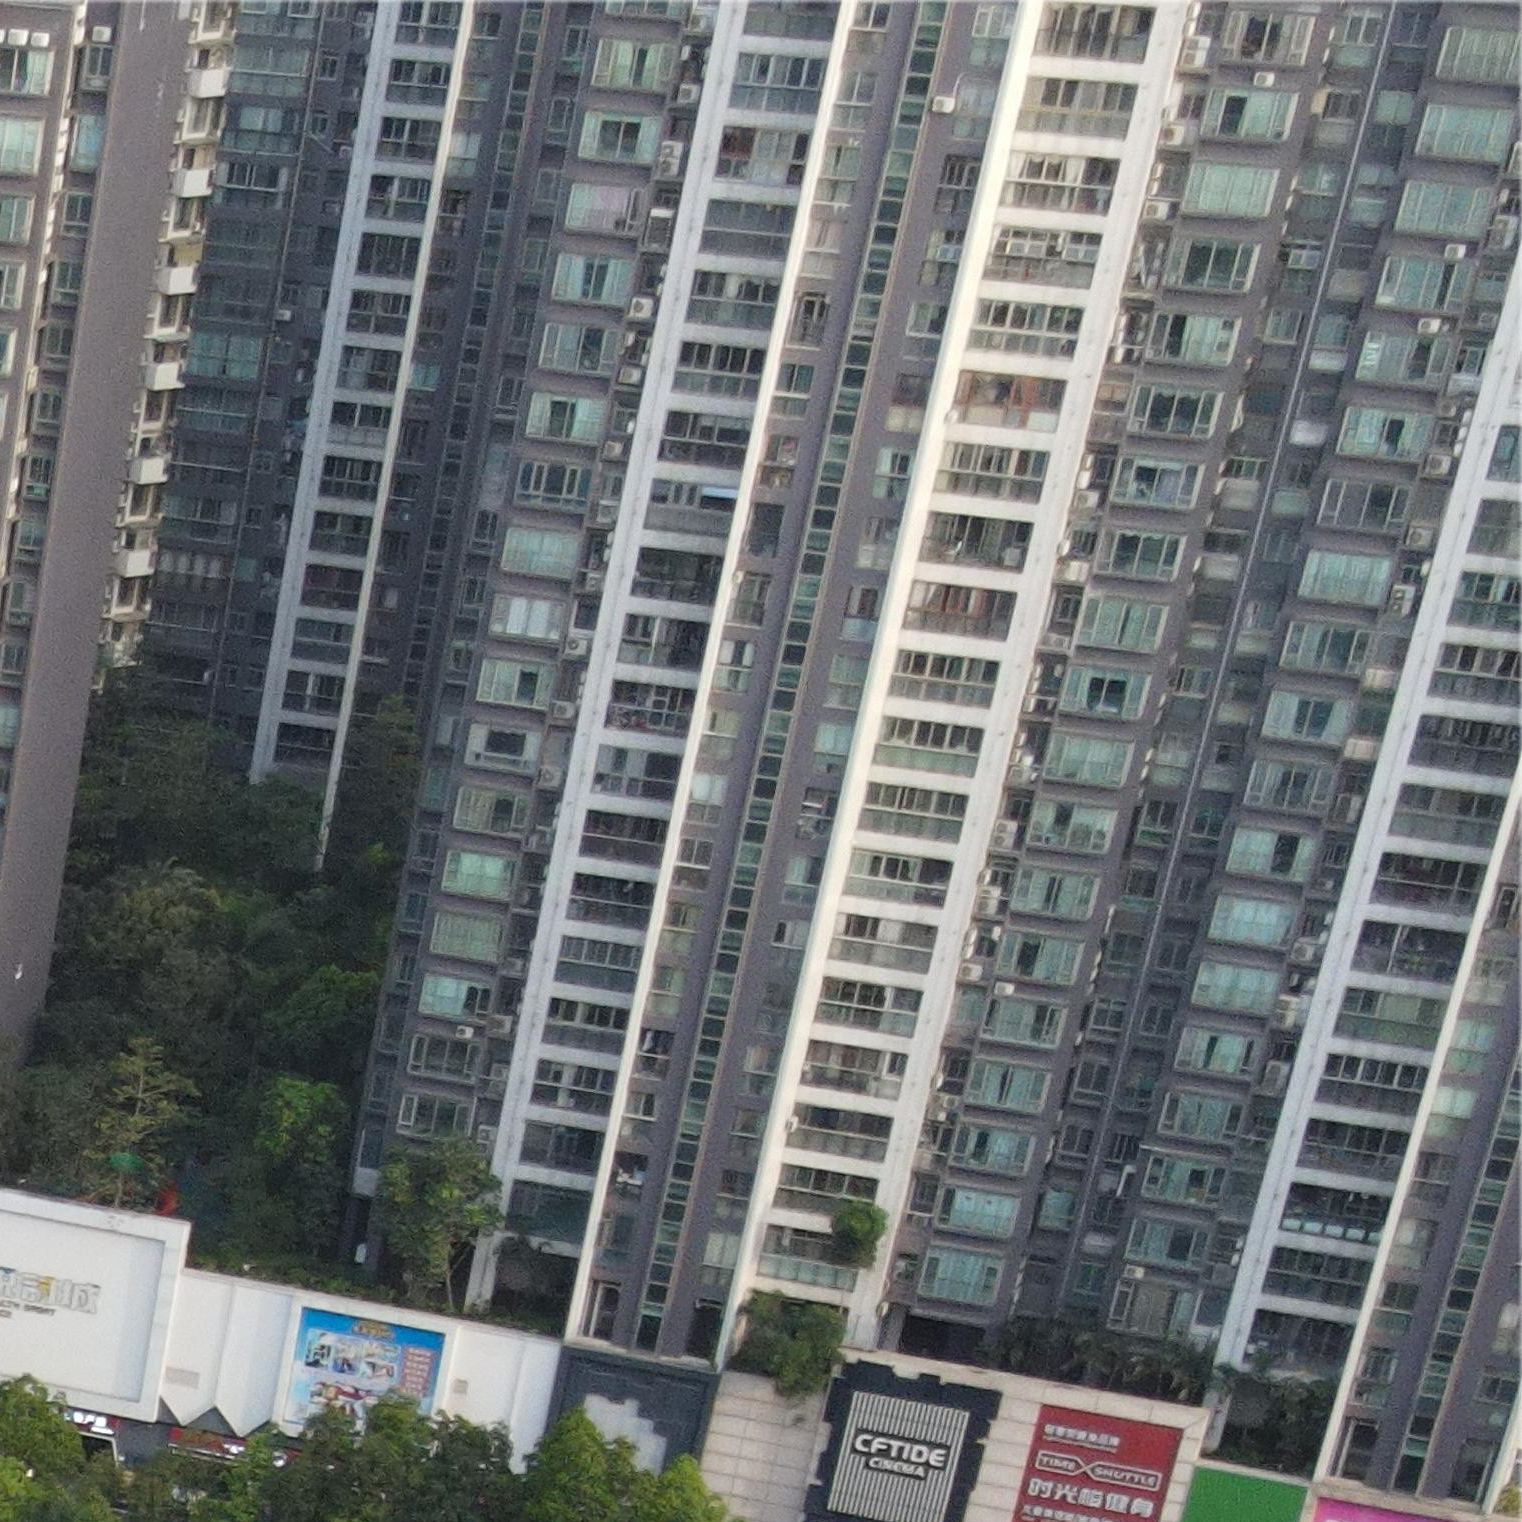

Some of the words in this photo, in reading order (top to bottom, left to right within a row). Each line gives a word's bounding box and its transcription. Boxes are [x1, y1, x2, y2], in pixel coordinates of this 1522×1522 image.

[854, 1434, 948, 1467] CFTIDE
[868, 1457, 925, 1478] CINEMA
[1041, 1456, 1076, 1471] TIME
[1093, 1467, 1156, 1487] SHUTTLE
